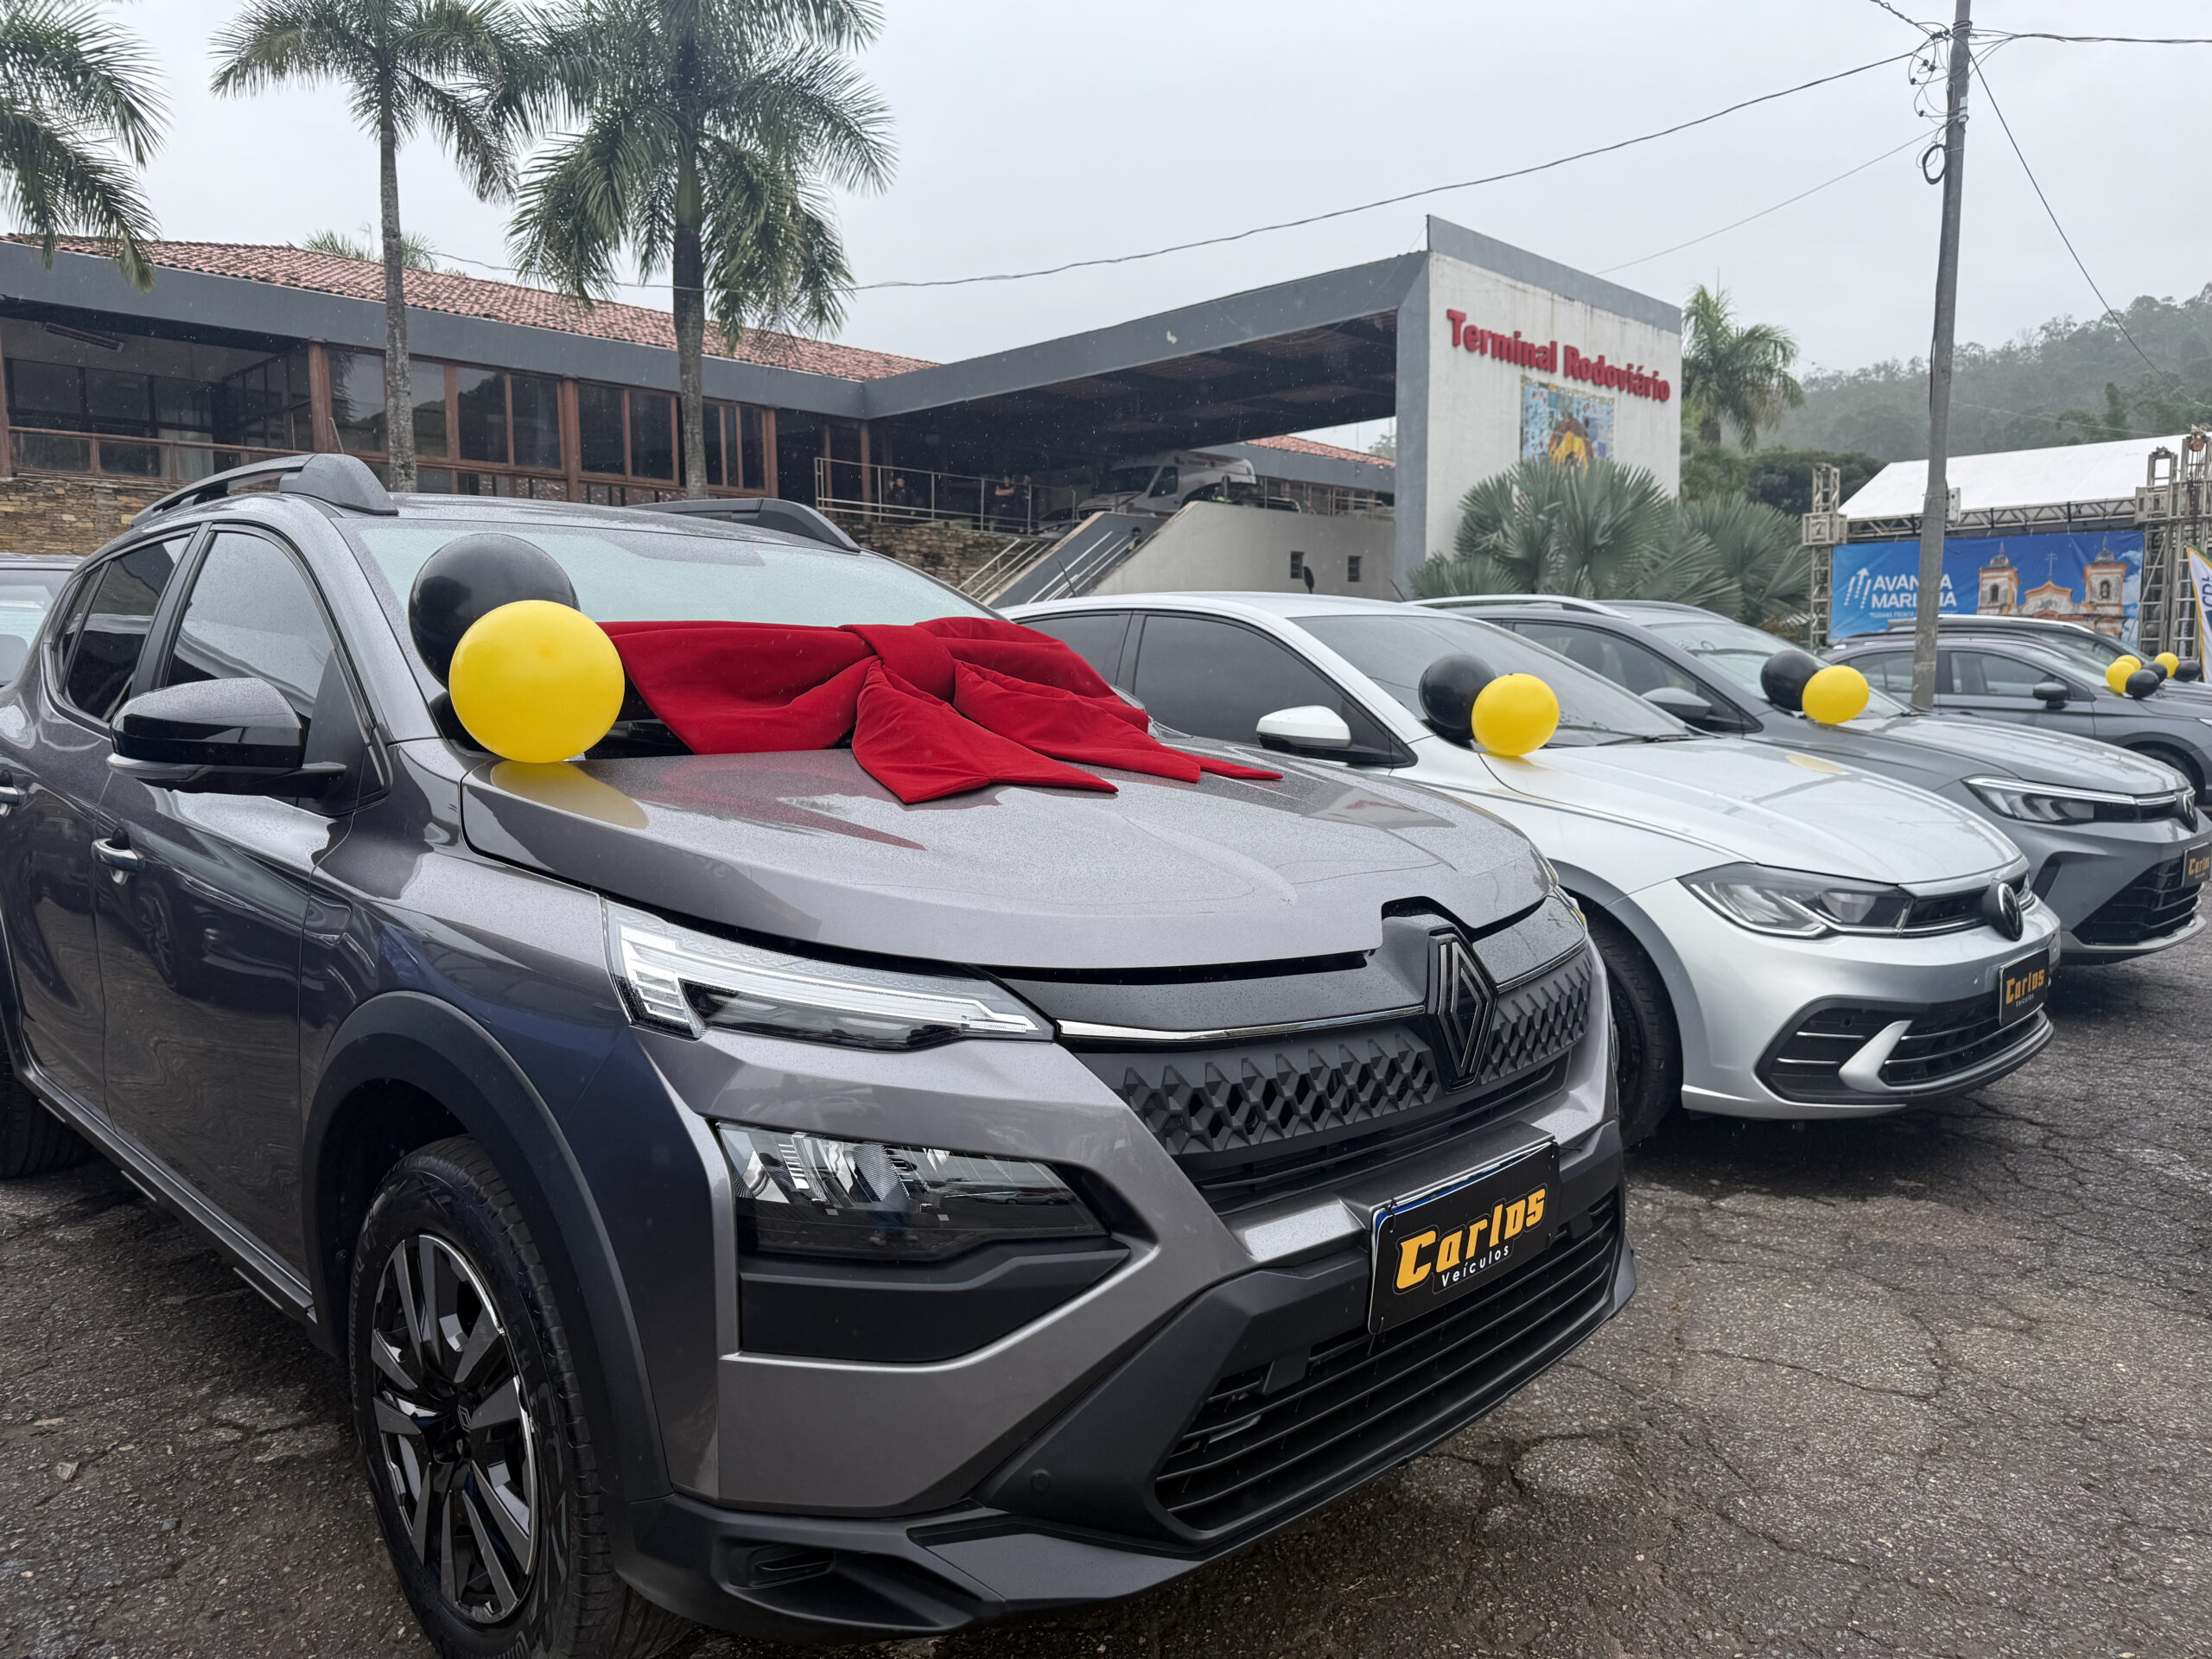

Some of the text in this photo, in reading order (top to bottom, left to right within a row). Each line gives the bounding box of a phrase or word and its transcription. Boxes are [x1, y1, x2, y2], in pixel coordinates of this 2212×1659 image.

[1446, 308, 1670, 403] Terminal Rodoviário
[1871, 591, 1957, 609] MARIA
[1872, 574, 1953, 591] AVANA
[2005, 969, 2045, 1005] Carlos
[1396, 1188, 1546, 1289] Carlos
[1441, 1244, 1510, 1287] Veículos
